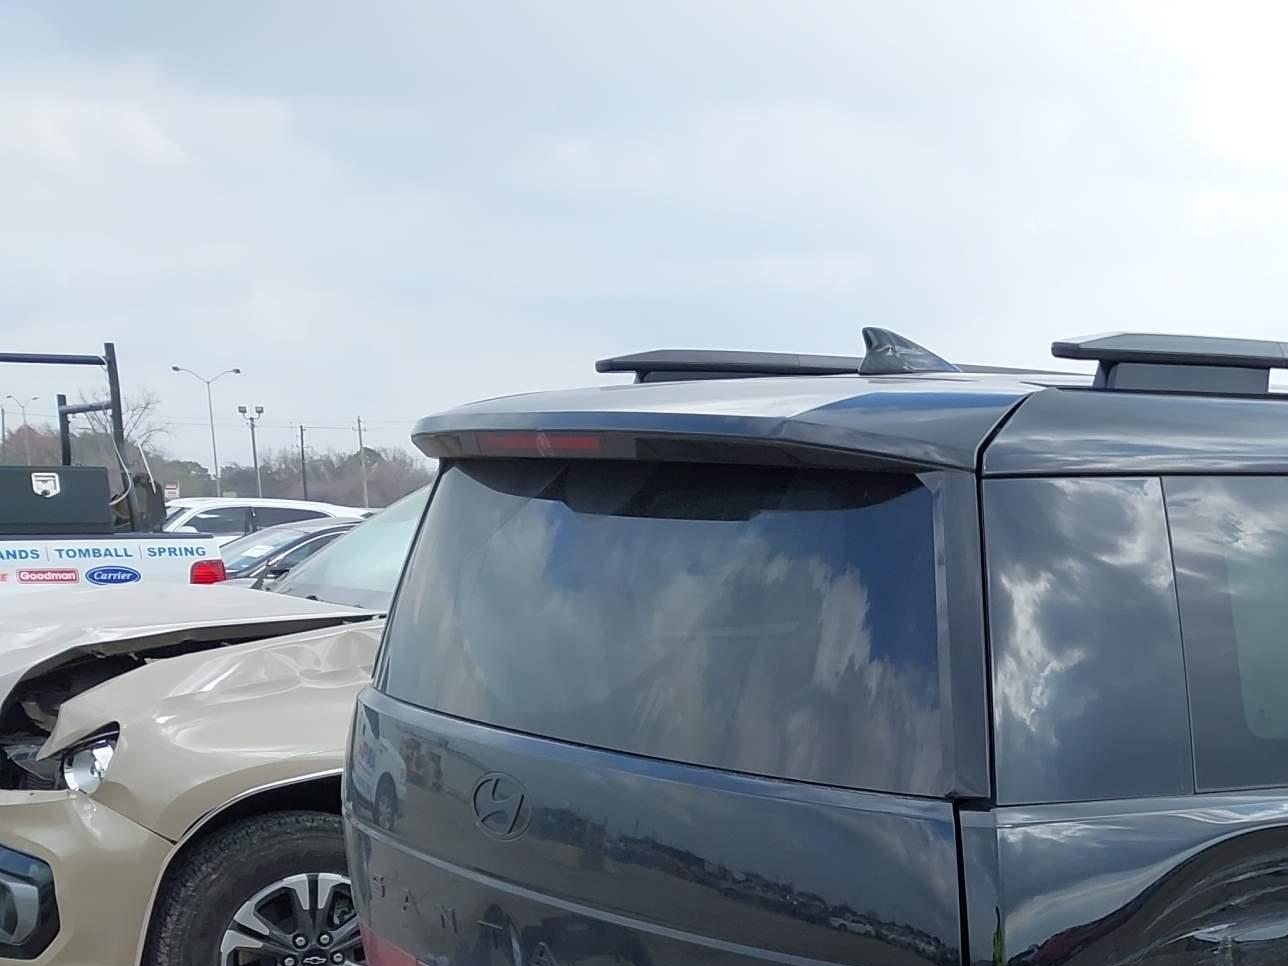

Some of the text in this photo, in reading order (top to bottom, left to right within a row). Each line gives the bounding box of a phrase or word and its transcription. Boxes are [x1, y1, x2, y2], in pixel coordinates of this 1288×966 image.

[54, 547, 133, 559] TOMBALL
[147, 546, 206, 557] SPRING
[20, 571, 76, 581] Goodman
[93, 570, 133, 581] Carrier
